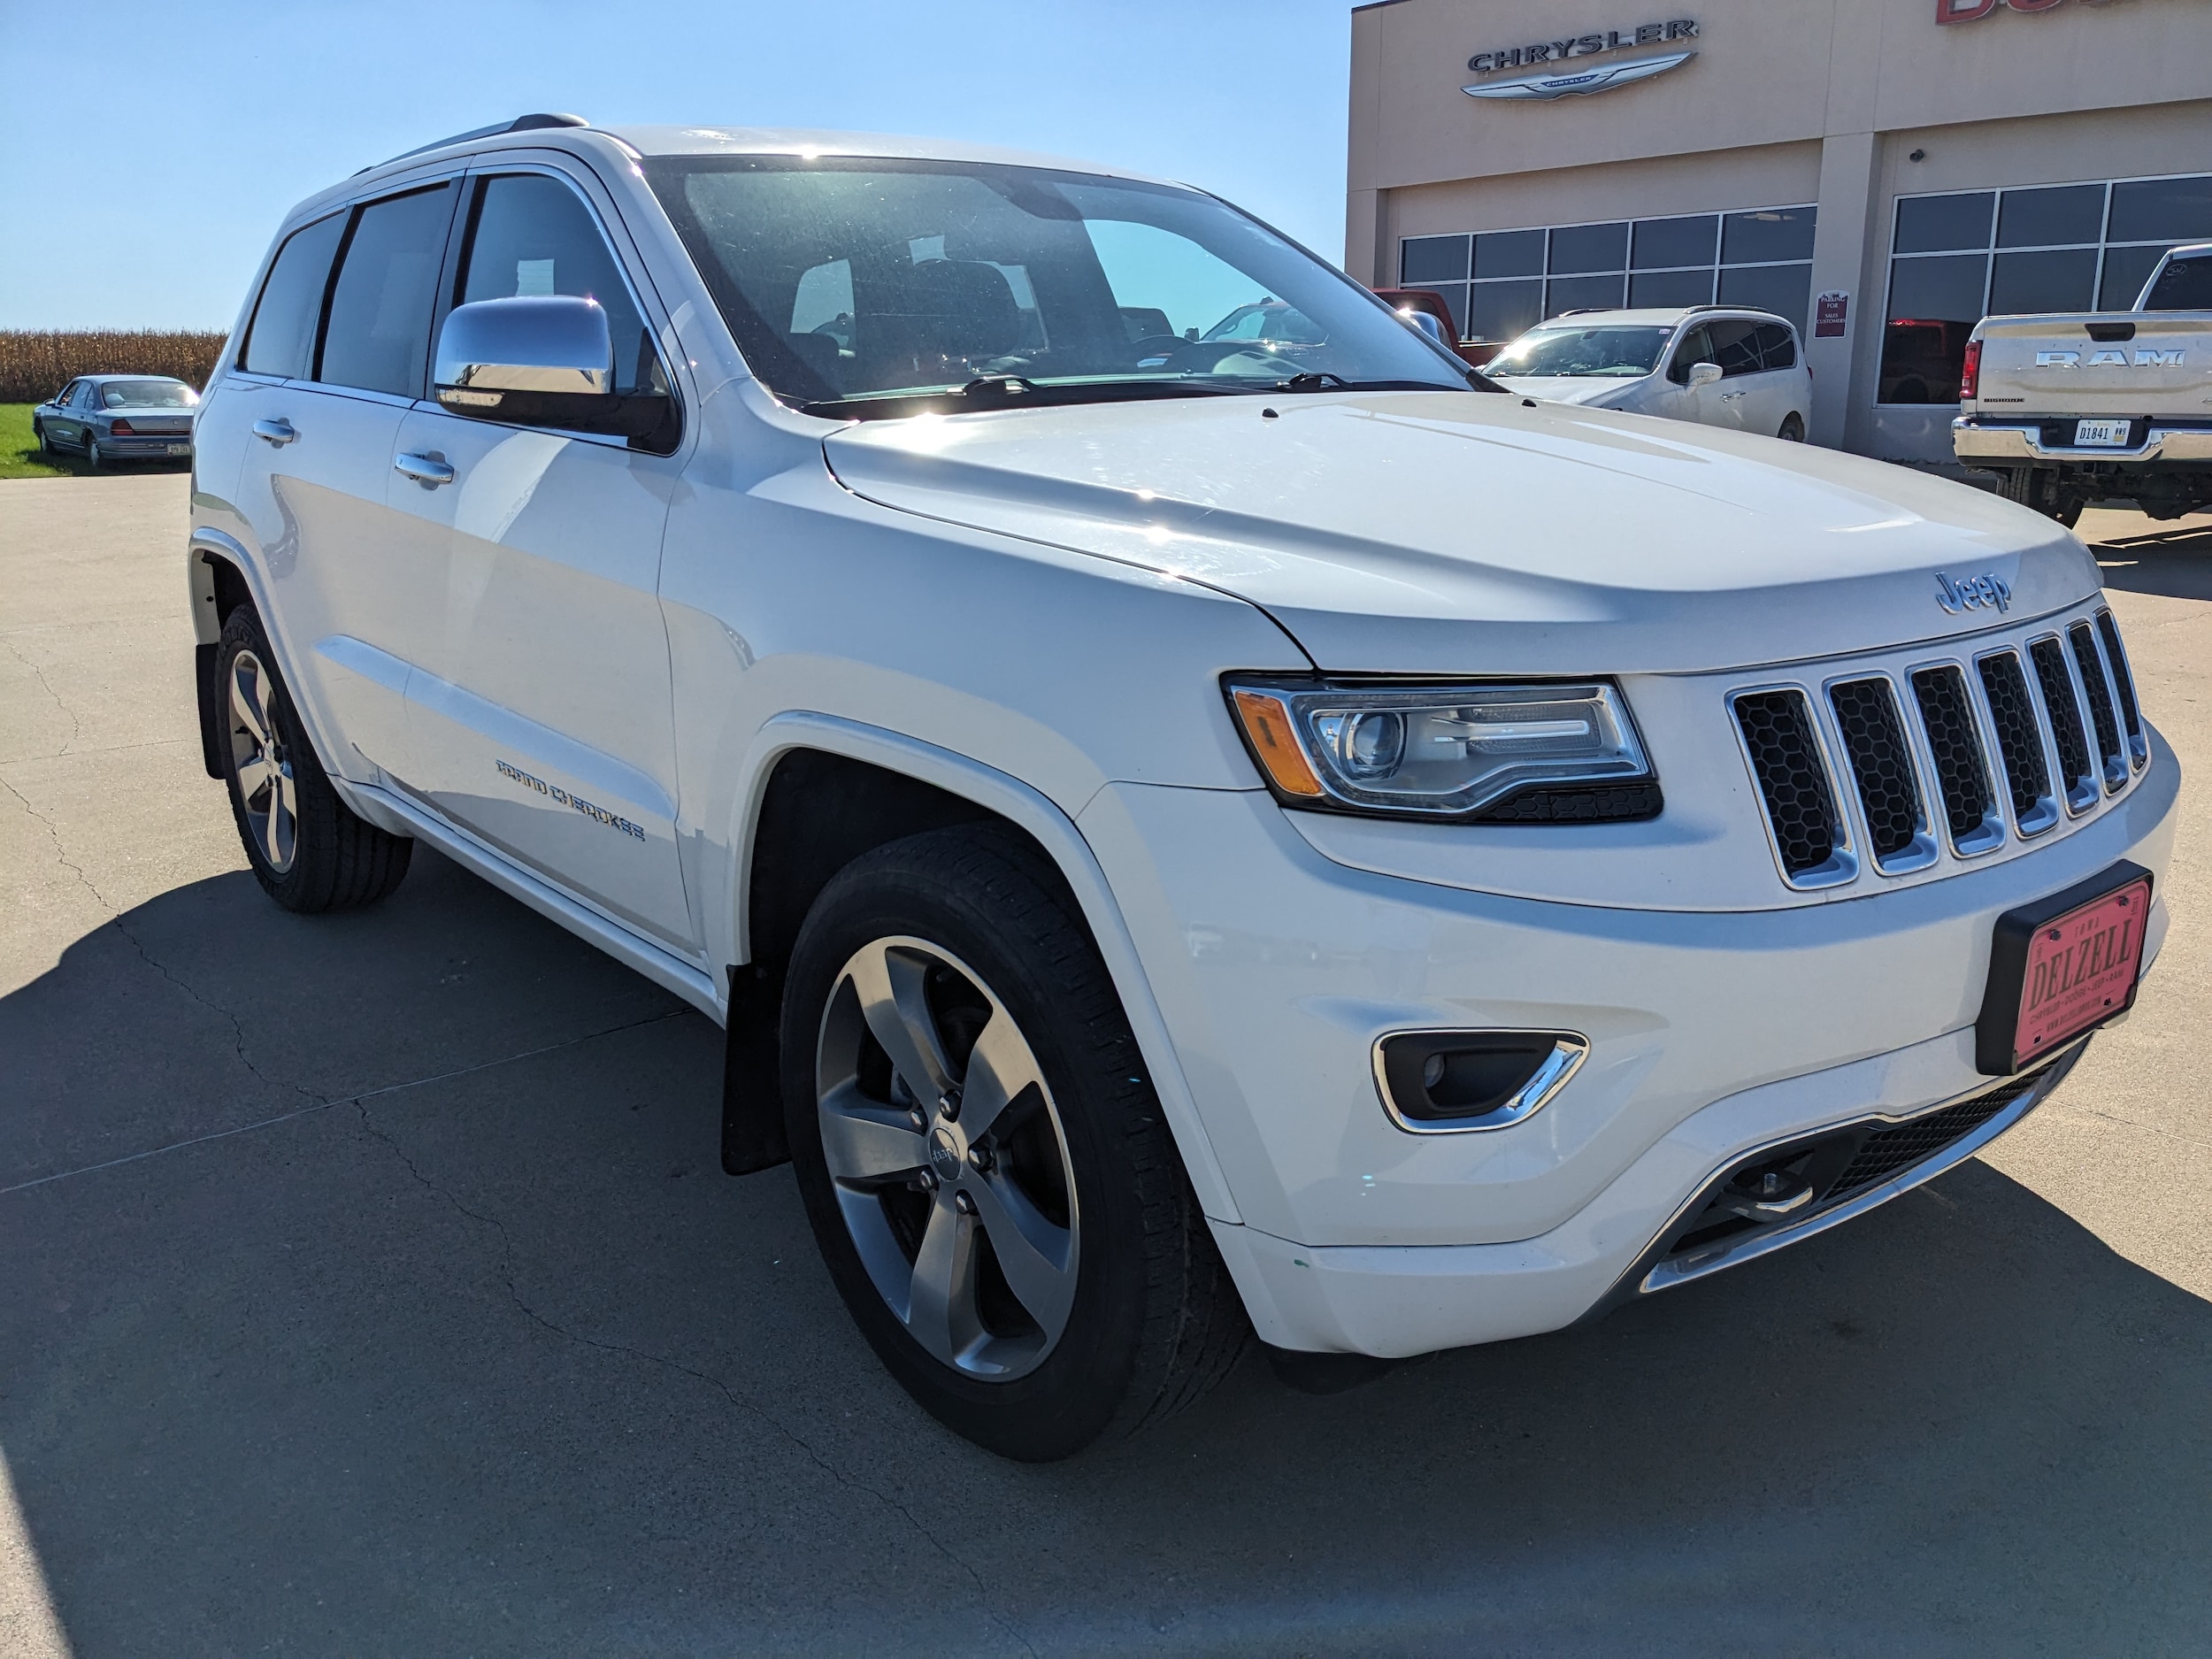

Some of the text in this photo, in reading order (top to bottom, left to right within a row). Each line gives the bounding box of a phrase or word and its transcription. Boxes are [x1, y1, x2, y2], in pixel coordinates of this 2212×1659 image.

[1467, 19, 1696, 72] CHRYSLER
[1546, 76, 1592, 86] CHRYSLER
[2036, 349, 2185, 368] RAM
[2079, 426, 2108, 440] D1841
[1935, 572, 2011, 615] Jeep
[549, 785, 646, 841] CHEROKEE
[2028, 918, 2132, 1012] DELZELL
